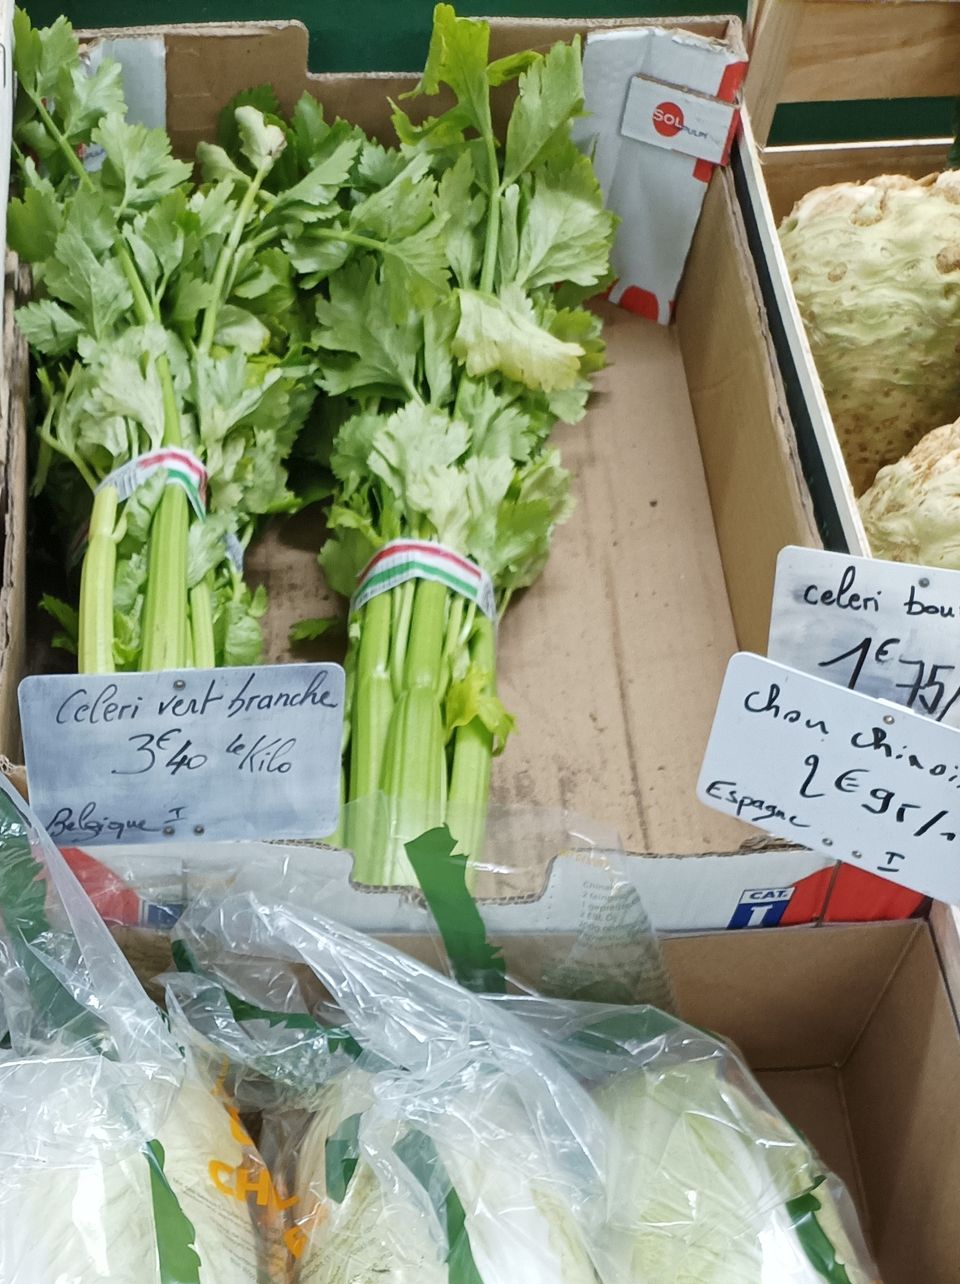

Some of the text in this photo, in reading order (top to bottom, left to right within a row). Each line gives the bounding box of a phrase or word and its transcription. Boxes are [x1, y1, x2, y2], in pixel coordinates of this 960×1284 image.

[652, 108, 683, 129] SOL
[904, 585, 960, 619] bou
[157, 679, 223, 717] vert
[227, 670, 338, 718] branche
[45, 801, 161, 842] Belgique
